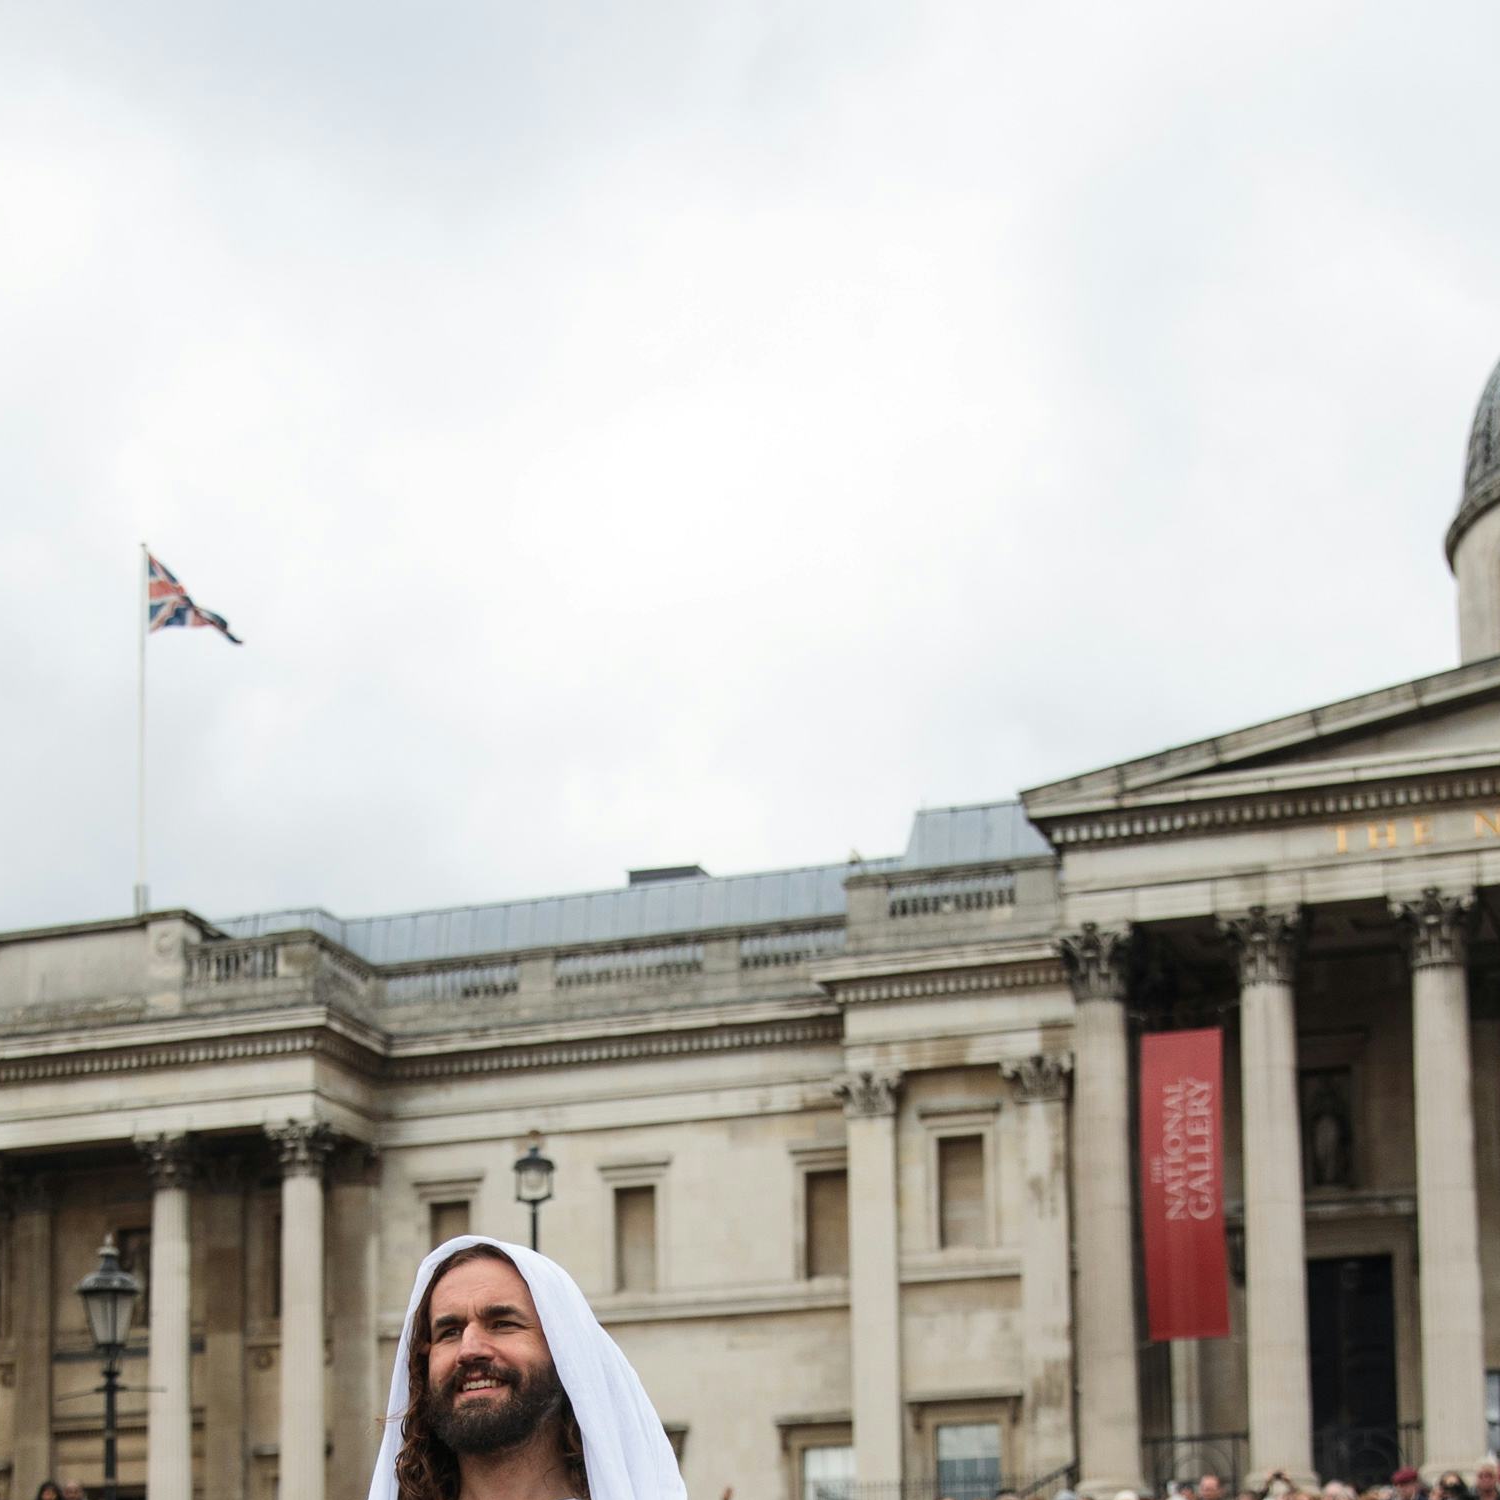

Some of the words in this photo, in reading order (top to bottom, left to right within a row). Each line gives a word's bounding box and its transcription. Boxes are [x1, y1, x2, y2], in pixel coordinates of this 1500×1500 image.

[1330, 818, 1434, 854] THE
[1163, 1078, 1188, 1221] NATIONAL
[1186, 1075, 1216, 1221] GALLERY
